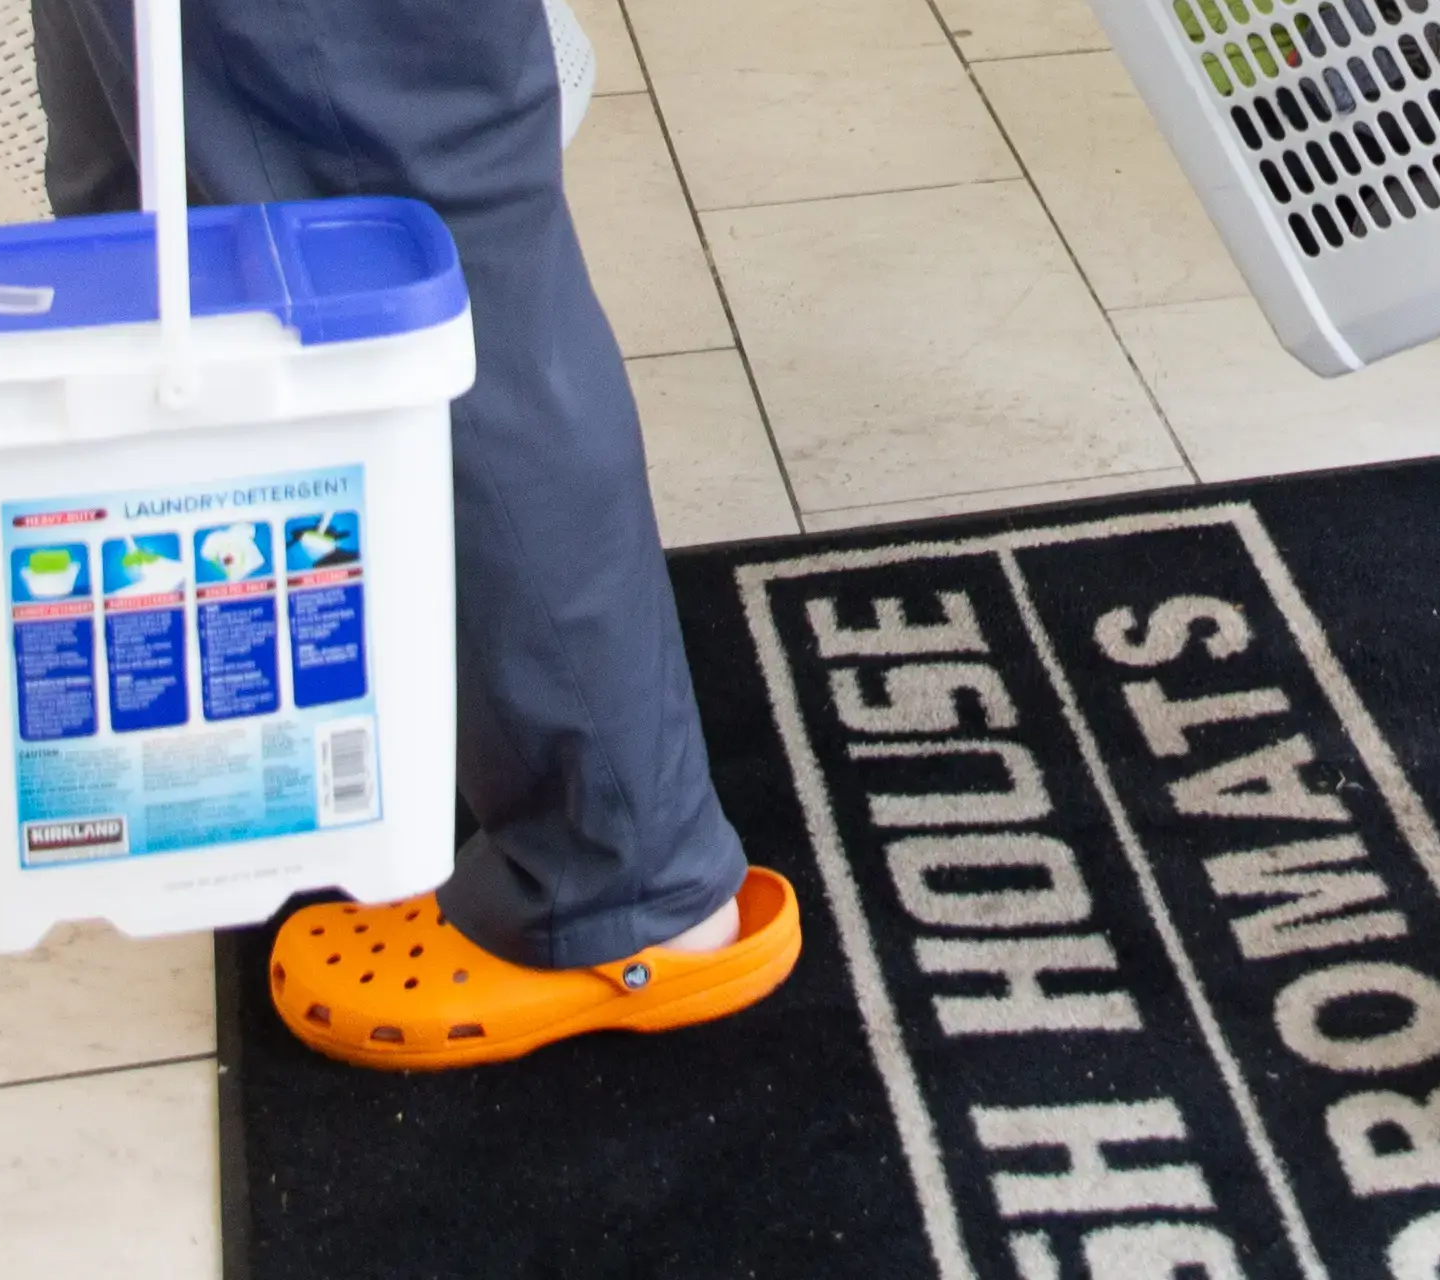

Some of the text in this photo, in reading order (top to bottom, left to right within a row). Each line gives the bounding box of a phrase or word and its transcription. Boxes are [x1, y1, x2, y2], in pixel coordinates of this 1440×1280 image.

[123, 476, 350, 521] LAUNDRY DETERGENT
[31, 820, 121, 844] KIRKLAND
[805, 590, 1144, 1038] HOUSE
